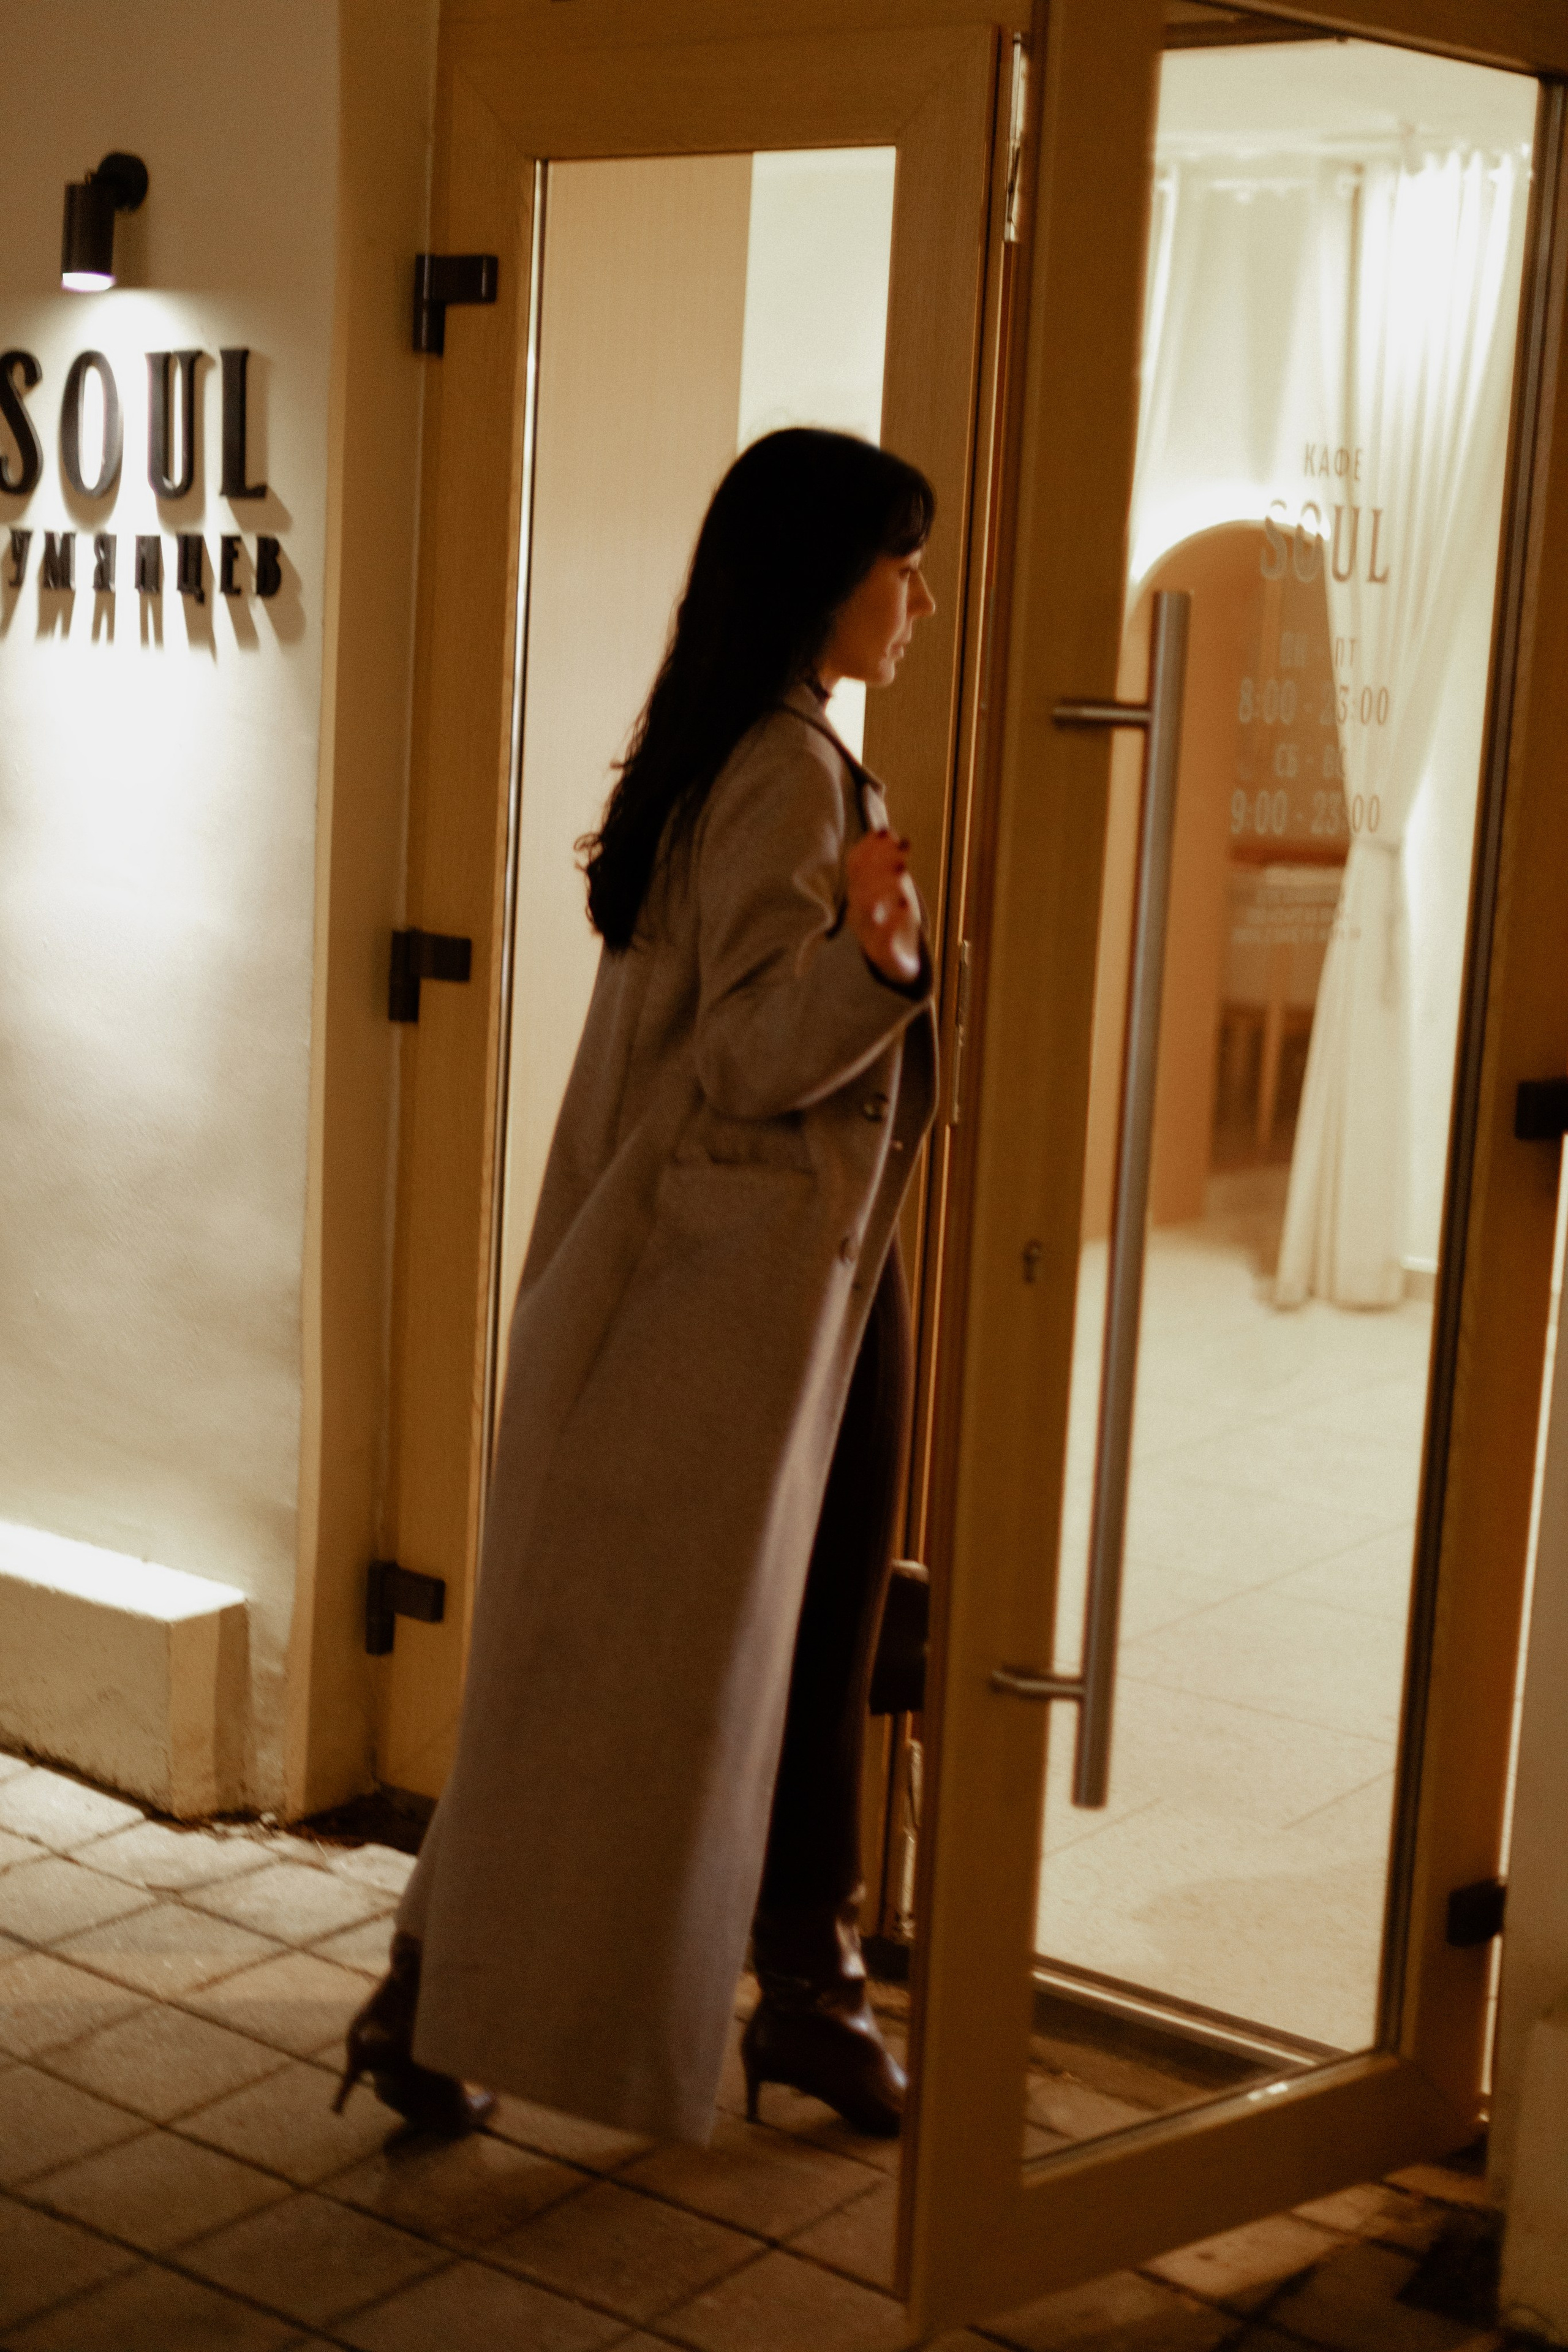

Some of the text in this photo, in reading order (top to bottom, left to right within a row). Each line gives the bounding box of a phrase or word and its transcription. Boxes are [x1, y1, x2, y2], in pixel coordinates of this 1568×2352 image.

[0, 348, 268, 500] SOUL
[1303, 442, 1362, 482] КАФЕ
[1260, 498, 1391, 584] SOUL
